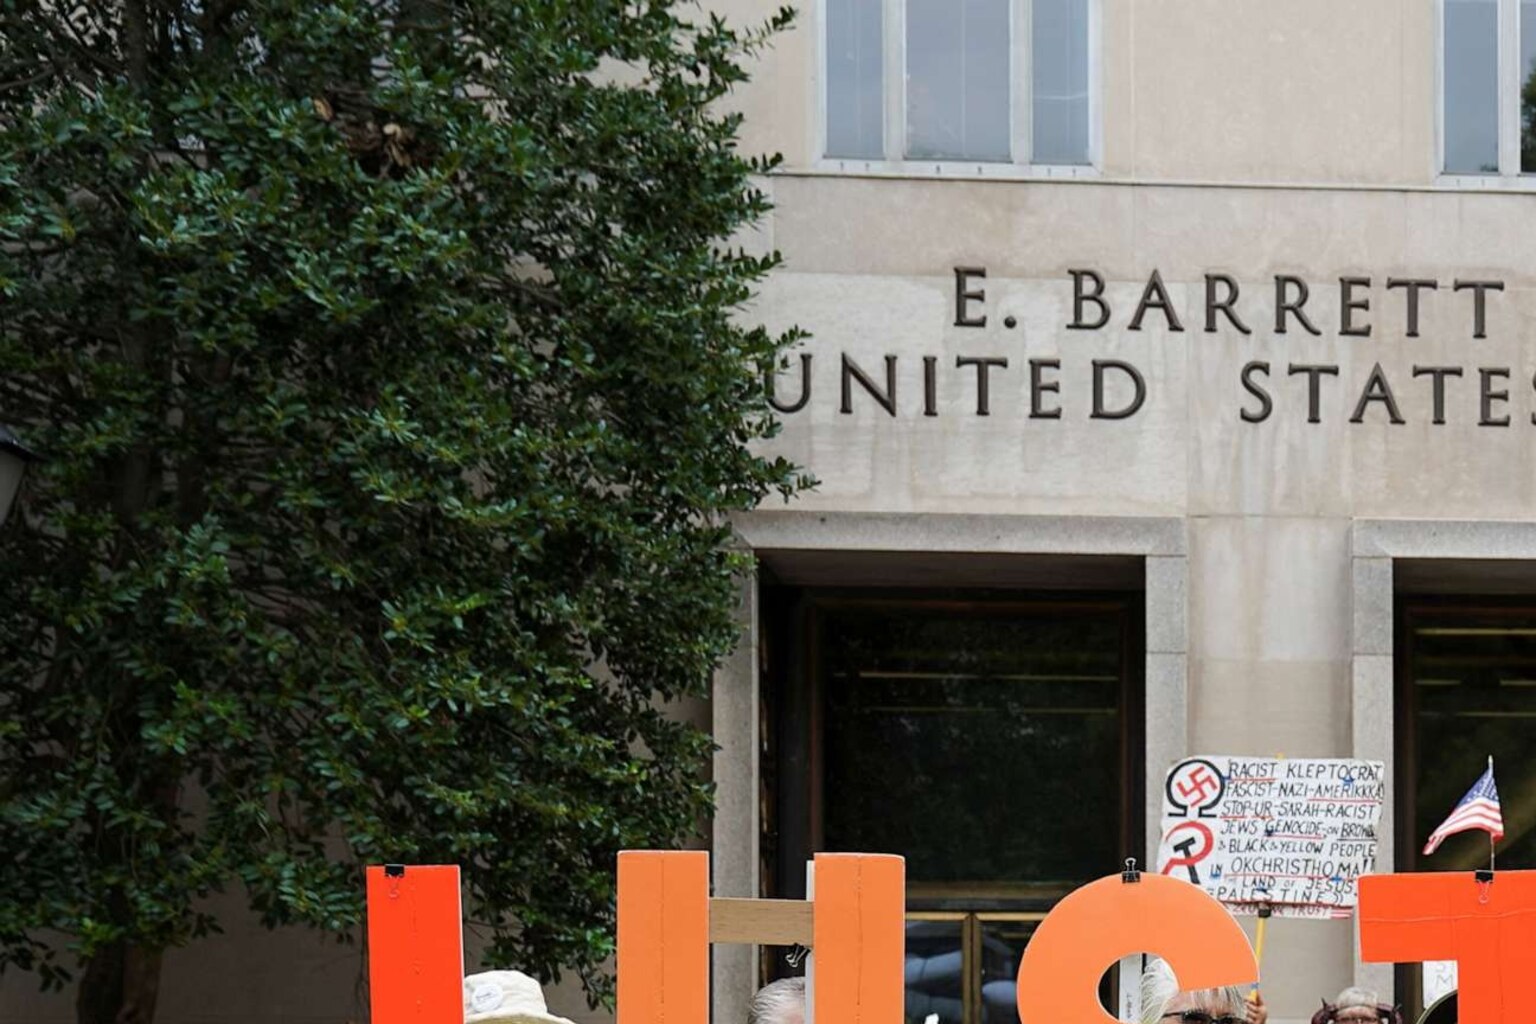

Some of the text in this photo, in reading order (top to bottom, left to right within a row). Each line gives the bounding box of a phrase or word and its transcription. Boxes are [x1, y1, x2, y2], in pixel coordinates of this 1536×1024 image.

[953, 266, 1018, 329] E.
[1066, 268, 1505, 338] BARRETT
[764, 351, 1148, 420] UNITED
[1228, 761, 1382, 781] RACIST KLEPTOCRAT
[1220, 820, 1258, 836] JEWS
[1228, 838, 1268, 854] BLACK
[1329, 842, 1376, 858] PEOPLE
[1242, 875, 1277, 890] LAND
